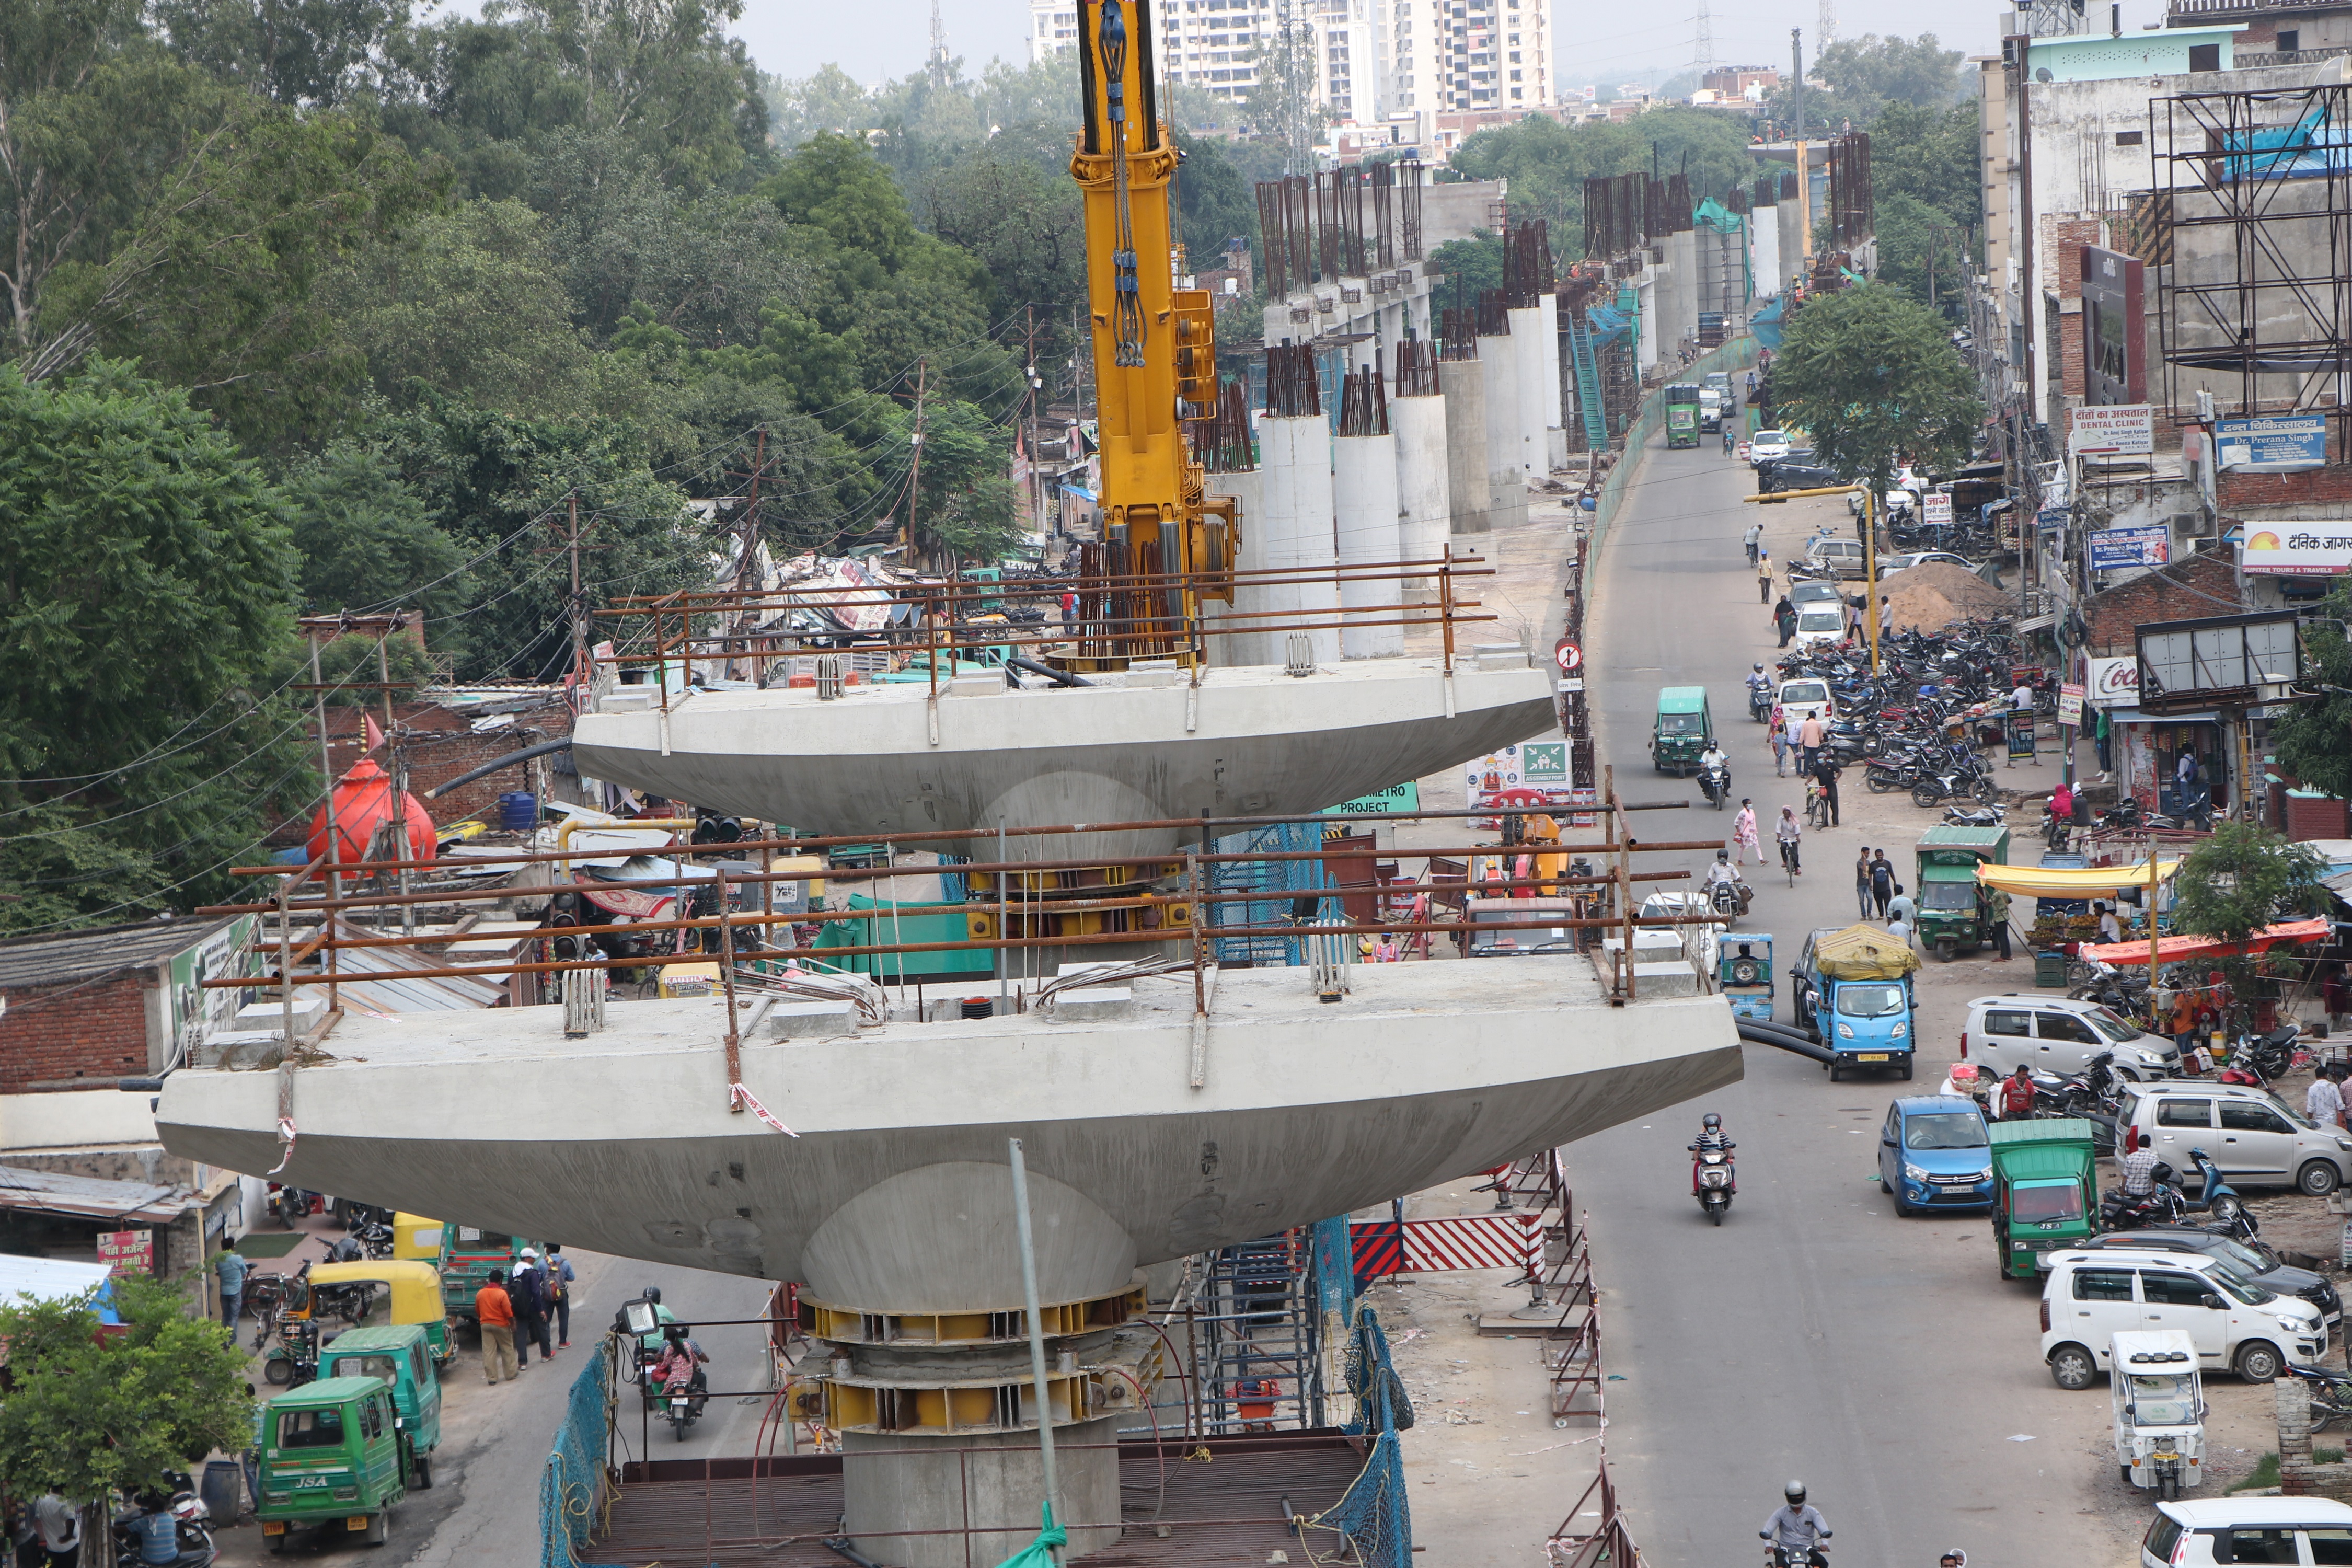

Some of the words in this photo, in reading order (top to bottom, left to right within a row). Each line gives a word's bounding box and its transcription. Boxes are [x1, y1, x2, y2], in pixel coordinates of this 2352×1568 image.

[2111, 409, 2149, 418] अस्पताल
[2223, 423, 2247, 432] दन्त
[2250, 419, 2317, 430] चिकित्सालय
[2251, 435, 2286, 444] Prerana
[2288, 433, 2314, 443] Singh
[2289, 533, 2320, 550] दैनिक
[1341, 802, 1389, 813] PROJECT
[295, 1477, 328, 1488] JSA
[264, 1524, 282, 1534] STOP
